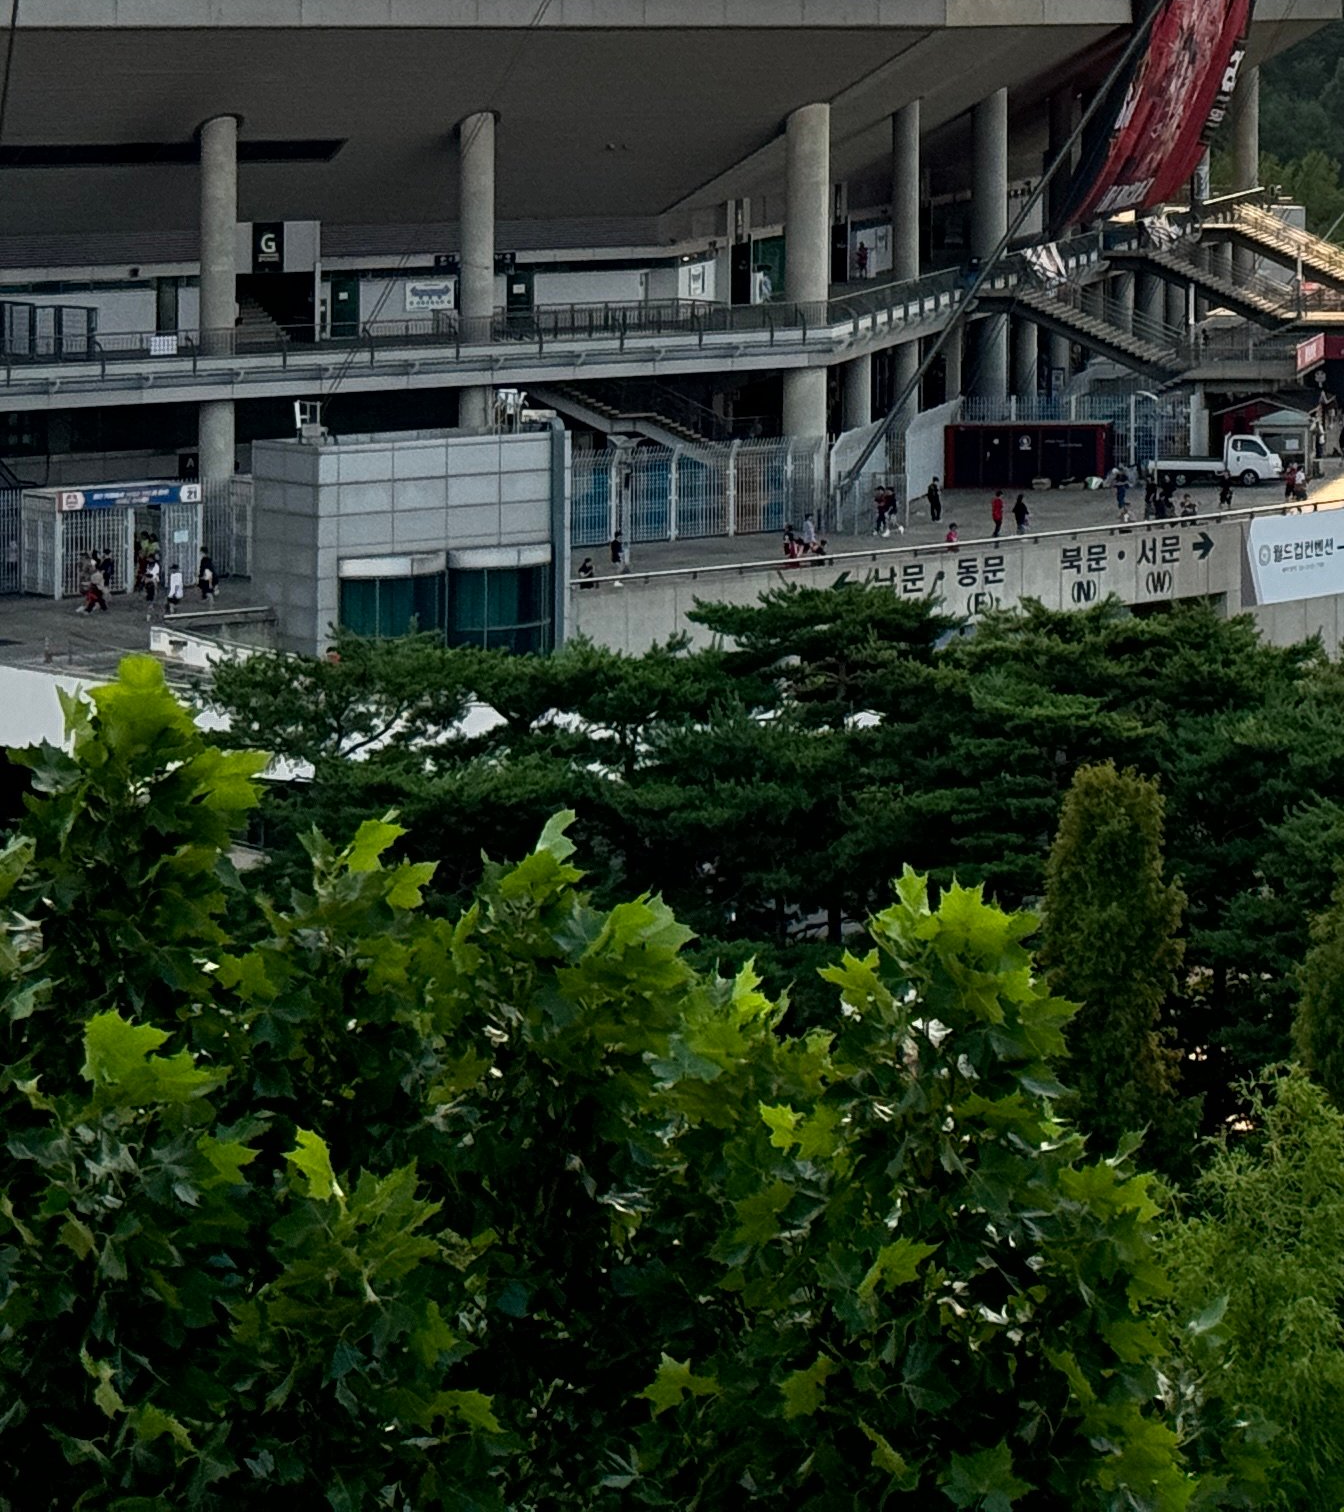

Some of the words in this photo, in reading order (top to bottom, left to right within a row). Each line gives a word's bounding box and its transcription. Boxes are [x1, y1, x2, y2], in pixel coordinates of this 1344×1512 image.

[260, 233, 276, 253] G
[957, 555, 1006, 587] 동문
[1061, 544, 1107, 575] 북문
[1137, 536, 1181, 565] 서문
[1071, 579, 1097, 604] (N)
[1146, 569, 1172, 595] (W)
